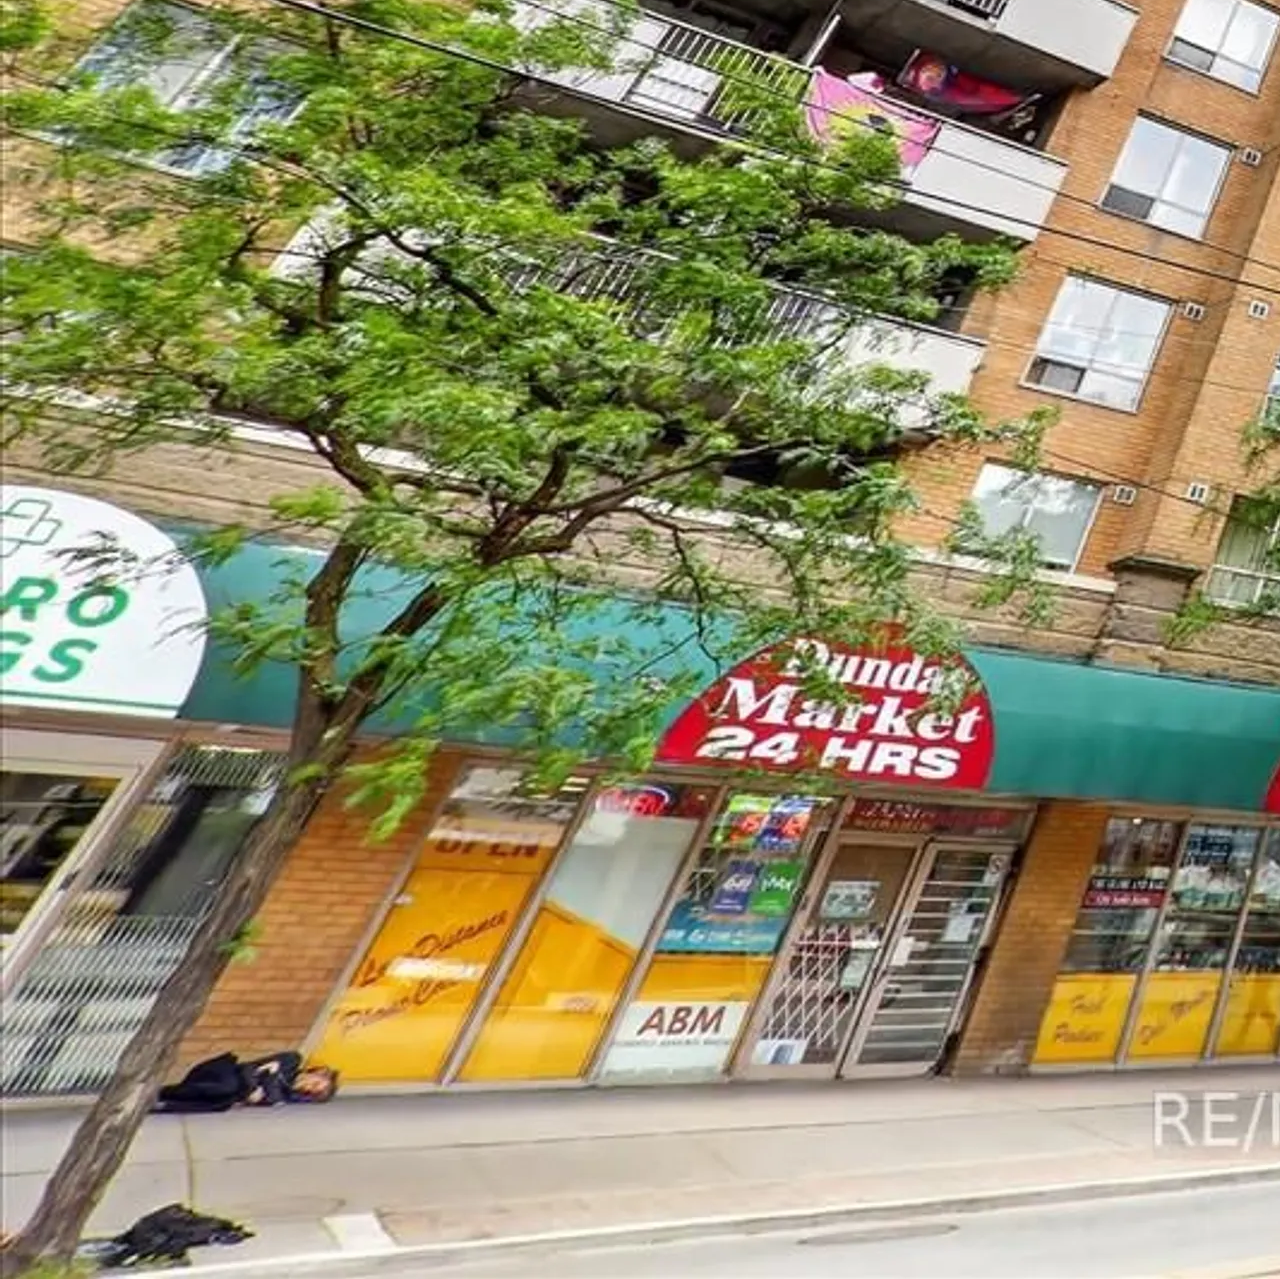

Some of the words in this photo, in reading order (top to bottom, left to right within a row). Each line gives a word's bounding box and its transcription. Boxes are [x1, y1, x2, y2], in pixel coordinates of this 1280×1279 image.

[706, 677, 983, 743] Market
[696, 726, 800, 765] 24
[820, 737, 960, 779] HRS
[637, 1005, 726, 1037] ABM
